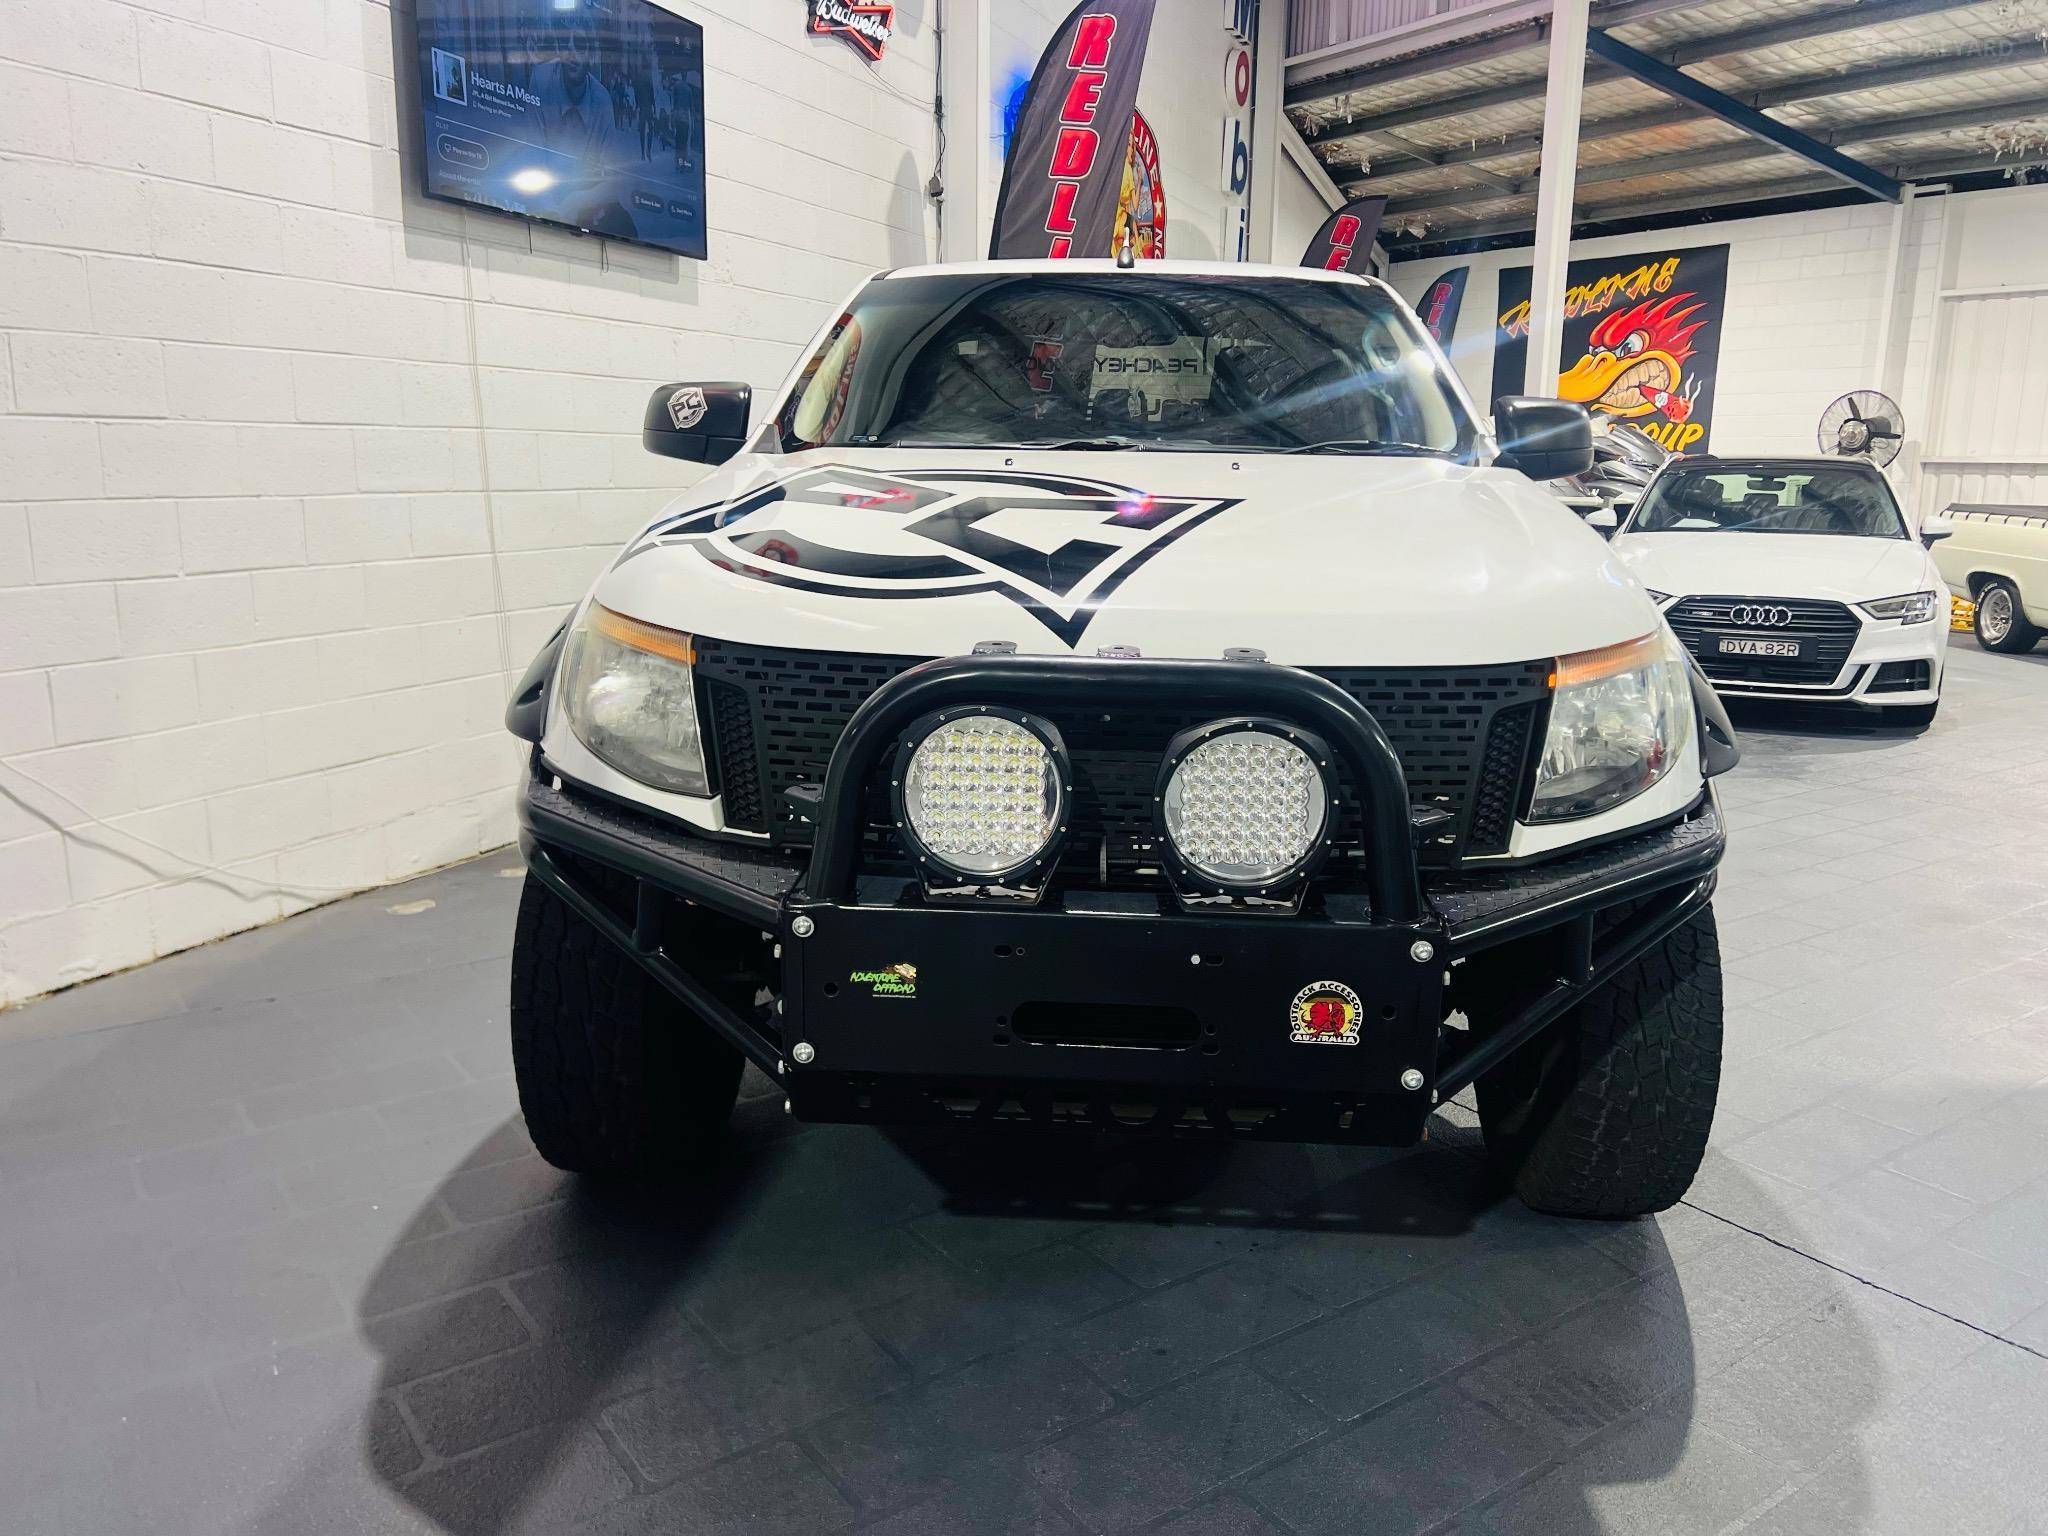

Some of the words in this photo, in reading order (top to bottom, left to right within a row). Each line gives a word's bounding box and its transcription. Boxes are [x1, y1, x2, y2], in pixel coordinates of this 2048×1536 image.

[816, 0, 889, 41] Budweiser
[471, 71, 505, 95] Hearts
[506, 83, 515, 98] A
[515, 86, 541, 107] Mess
[1499, 257, 1681, 339] RDLINE
[873, 983, 916, 993] OFFROAD
[1291, 985, 1316, 1031] OUTBACK
[1319, 983, 1361, 1034] ACCESSORIES
[1293, 1033, 1355, 1043] AUSTRALIA
